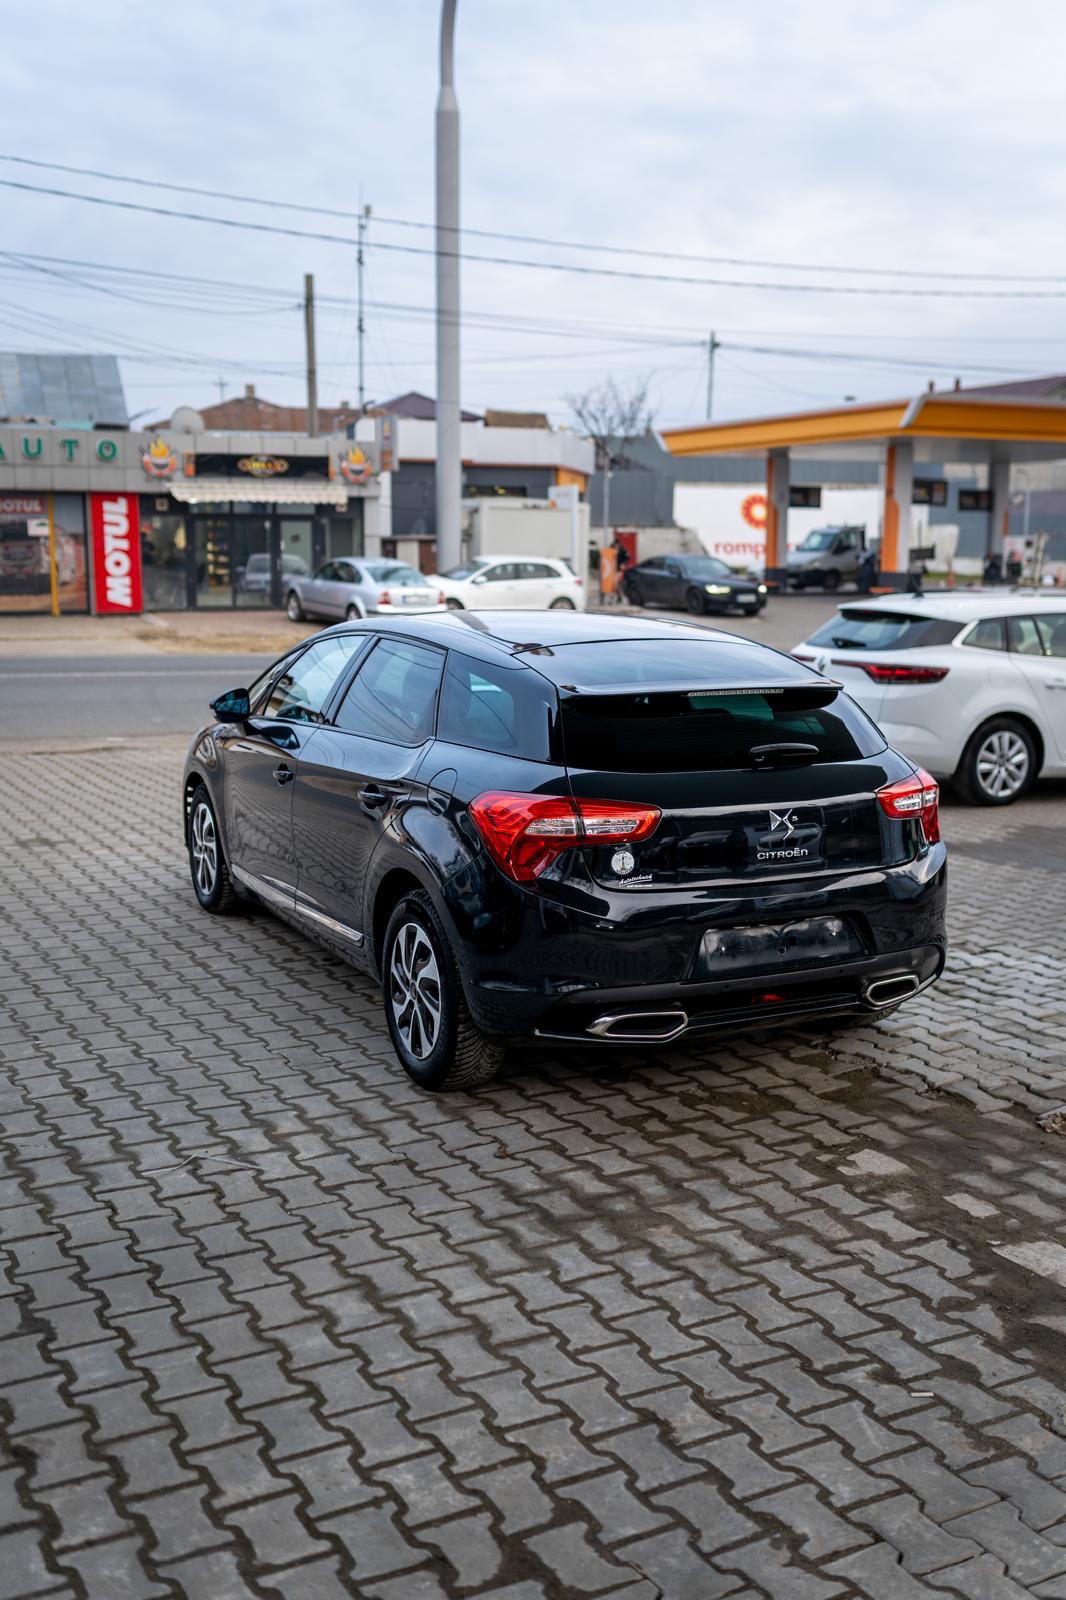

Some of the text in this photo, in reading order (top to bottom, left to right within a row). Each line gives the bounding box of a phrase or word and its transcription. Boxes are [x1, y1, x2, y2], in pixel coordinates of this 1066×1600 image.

[0, 437, 118, 461] UTO
[0, 498, 42, 513] OTUL
[102, 496, 133, 607] MOTUL
